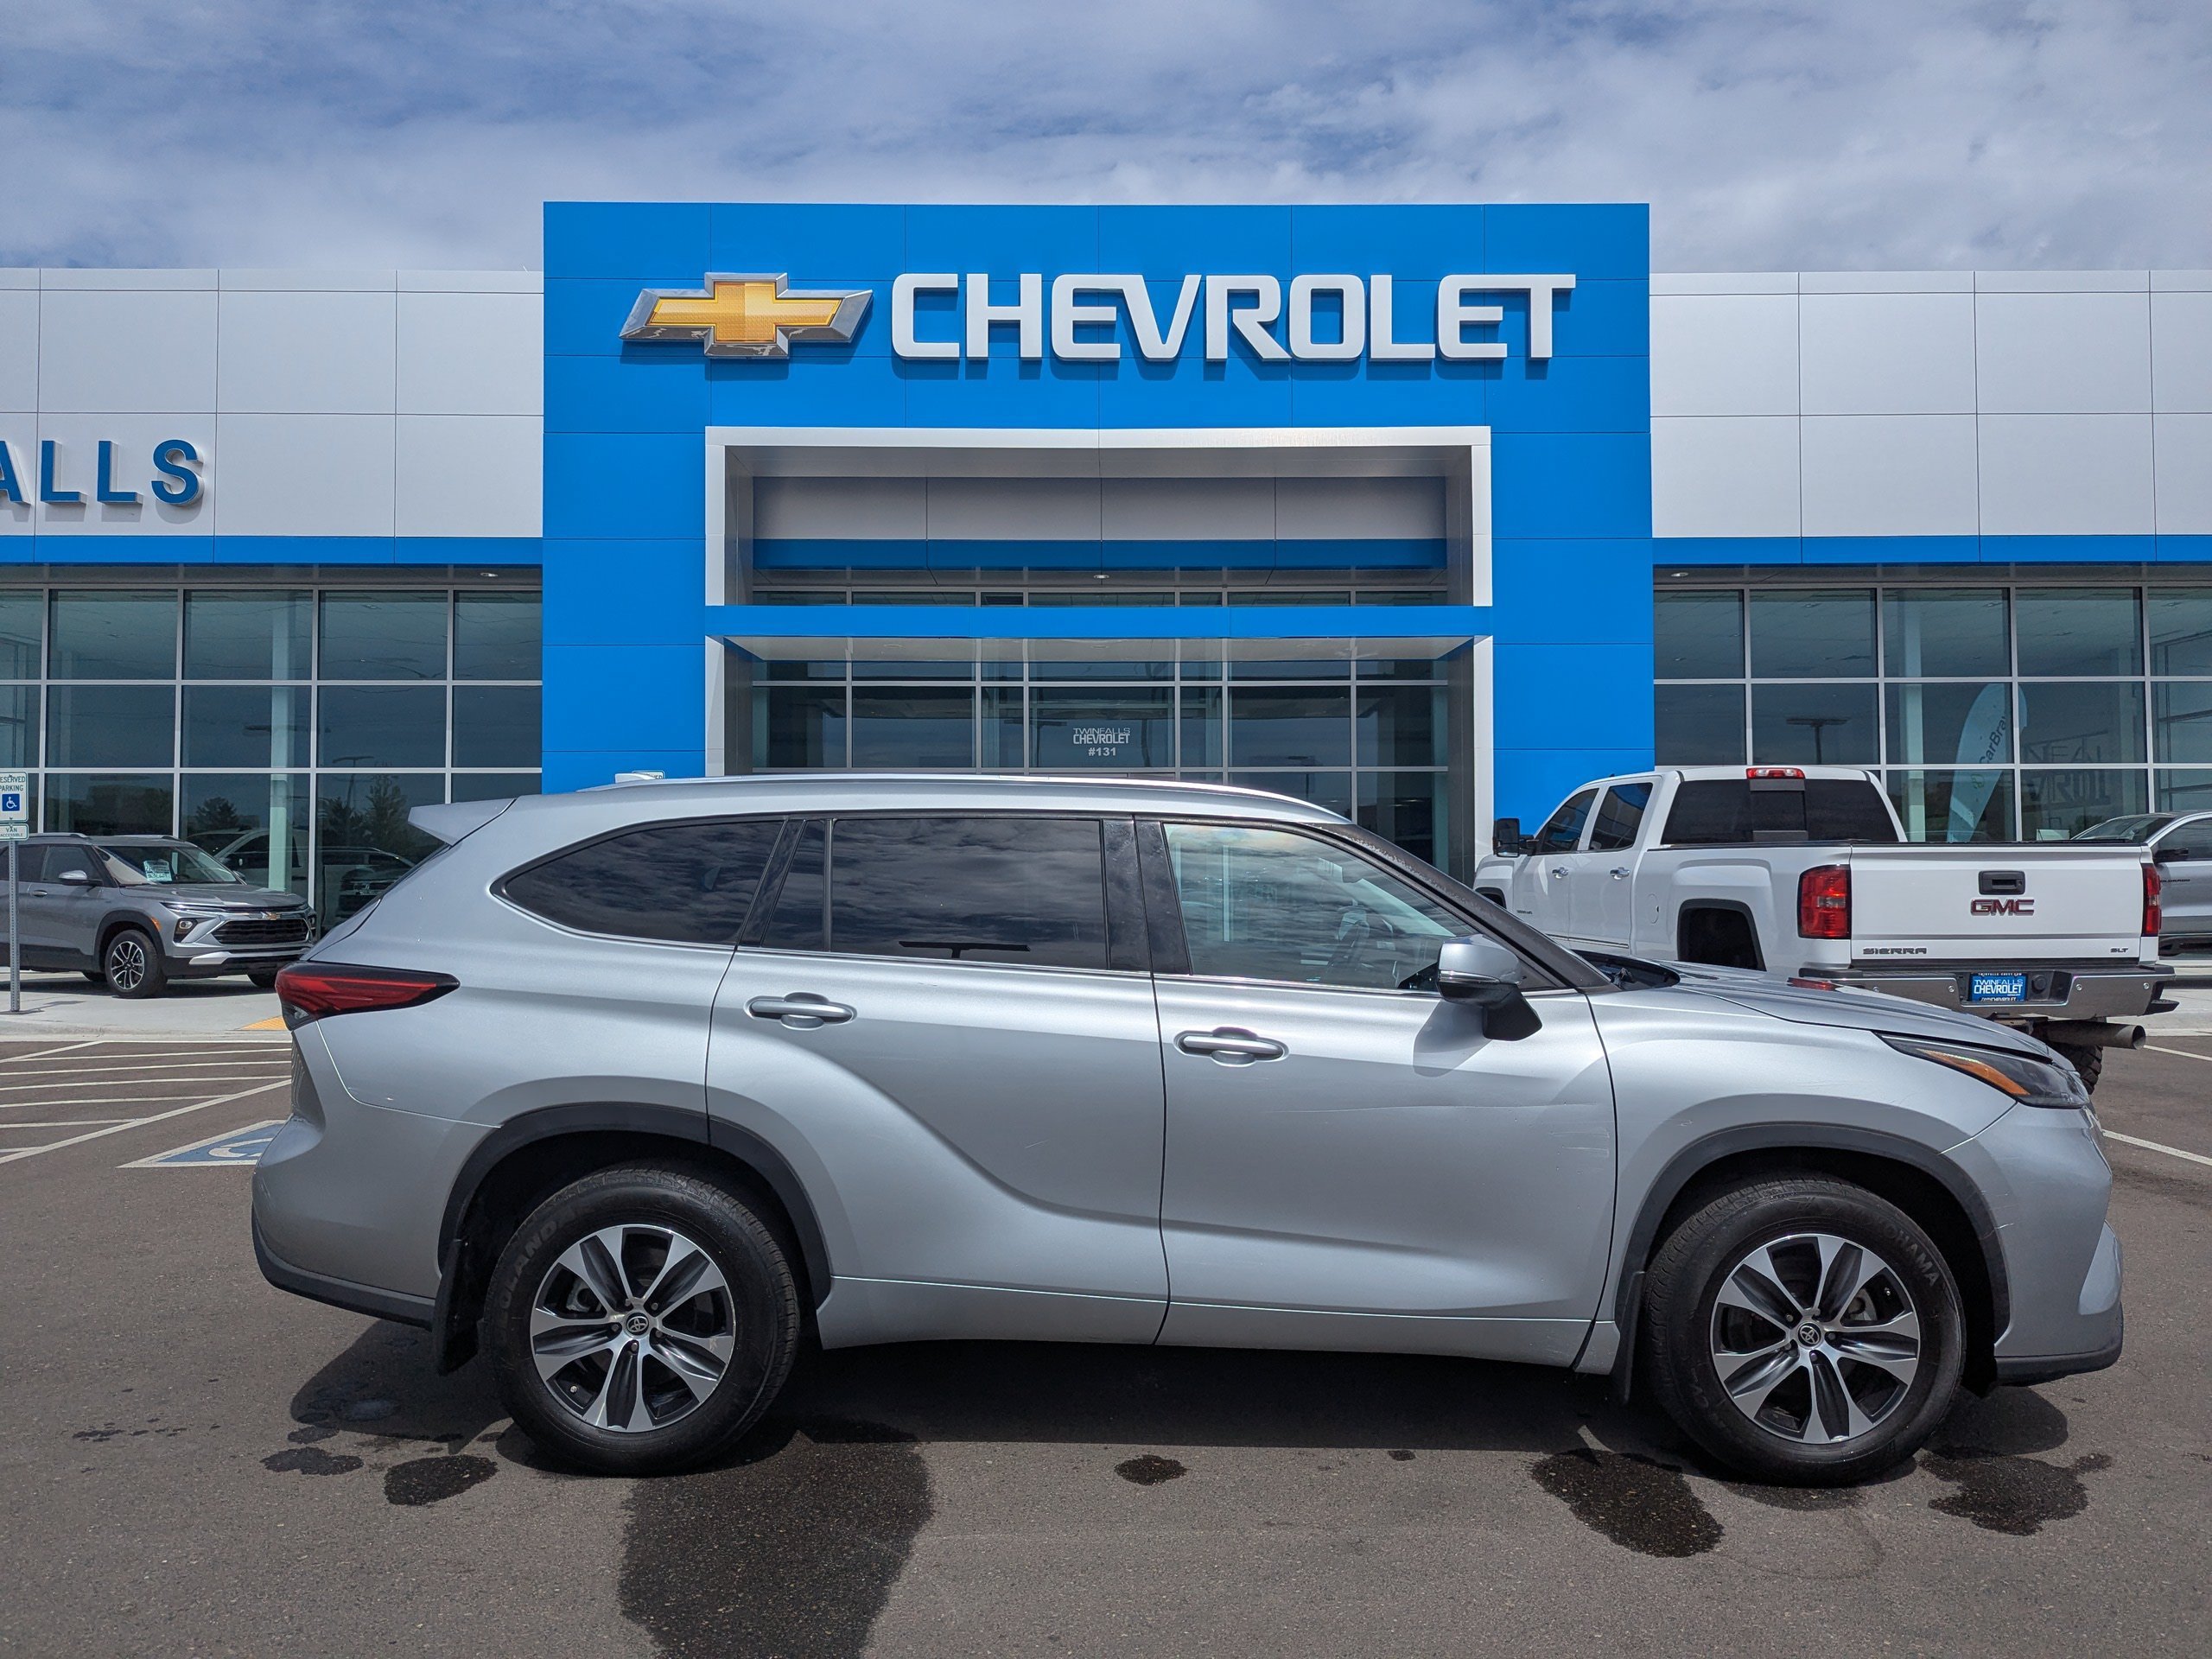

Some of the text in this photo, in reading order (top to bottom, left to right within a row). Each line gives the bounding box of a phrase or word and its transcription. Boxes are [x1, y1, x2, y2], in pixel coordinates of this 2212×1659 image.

[892, 273, 1576, 361] CHEVROLET
[0, 439, 202, 505] ALLS
[1073, 734, 1130, 744] CHEVROLET
[1979, 715, 2005, 764] CarBra
[1088, 747, 1116, 756] #131
[1971, 899, 2035, 916] GMC
[1974, 985, 2023, 995] CHEVROLET
